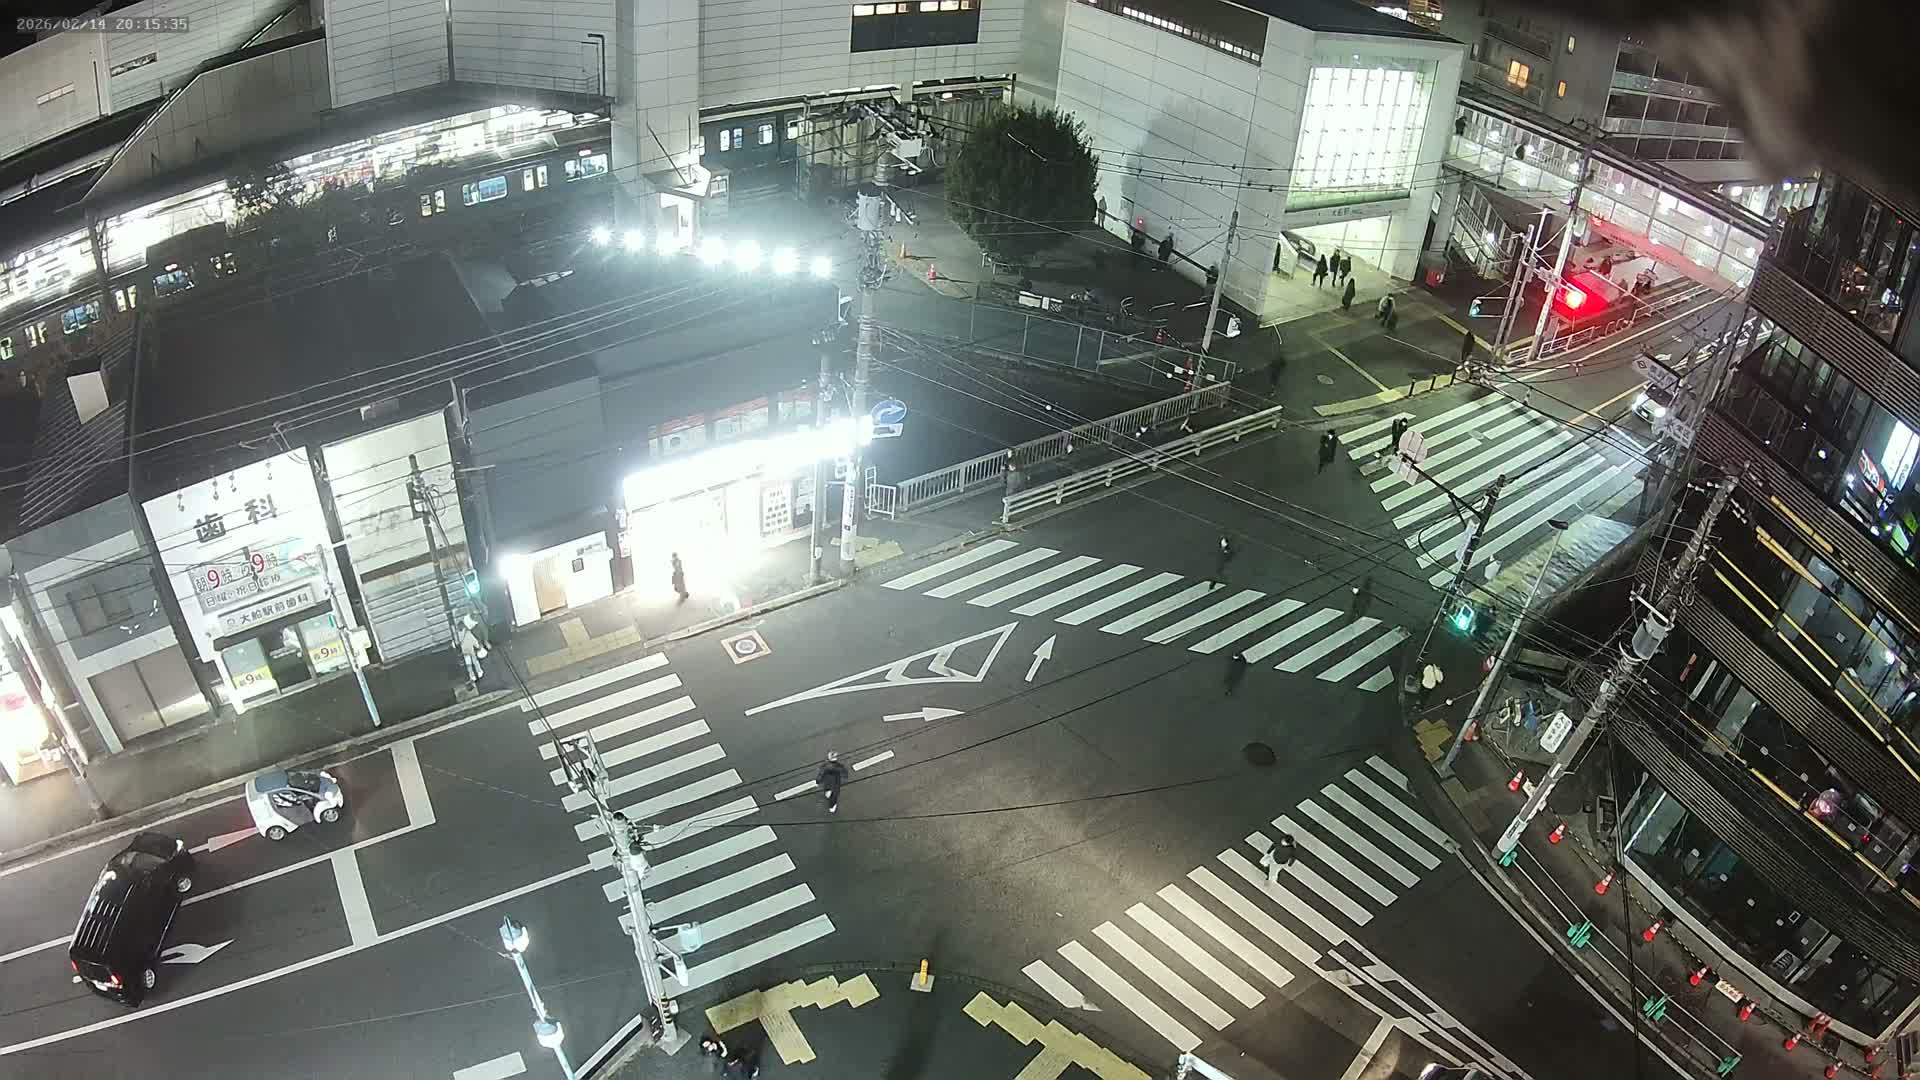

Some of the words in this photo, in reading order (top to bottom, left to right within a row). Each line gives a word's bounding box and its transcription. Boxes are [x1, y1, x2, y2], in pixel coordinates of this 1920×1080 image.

[193, 494, 278, 543] 歯科
[239, 592, 309, 625] 大船駅前歯科
